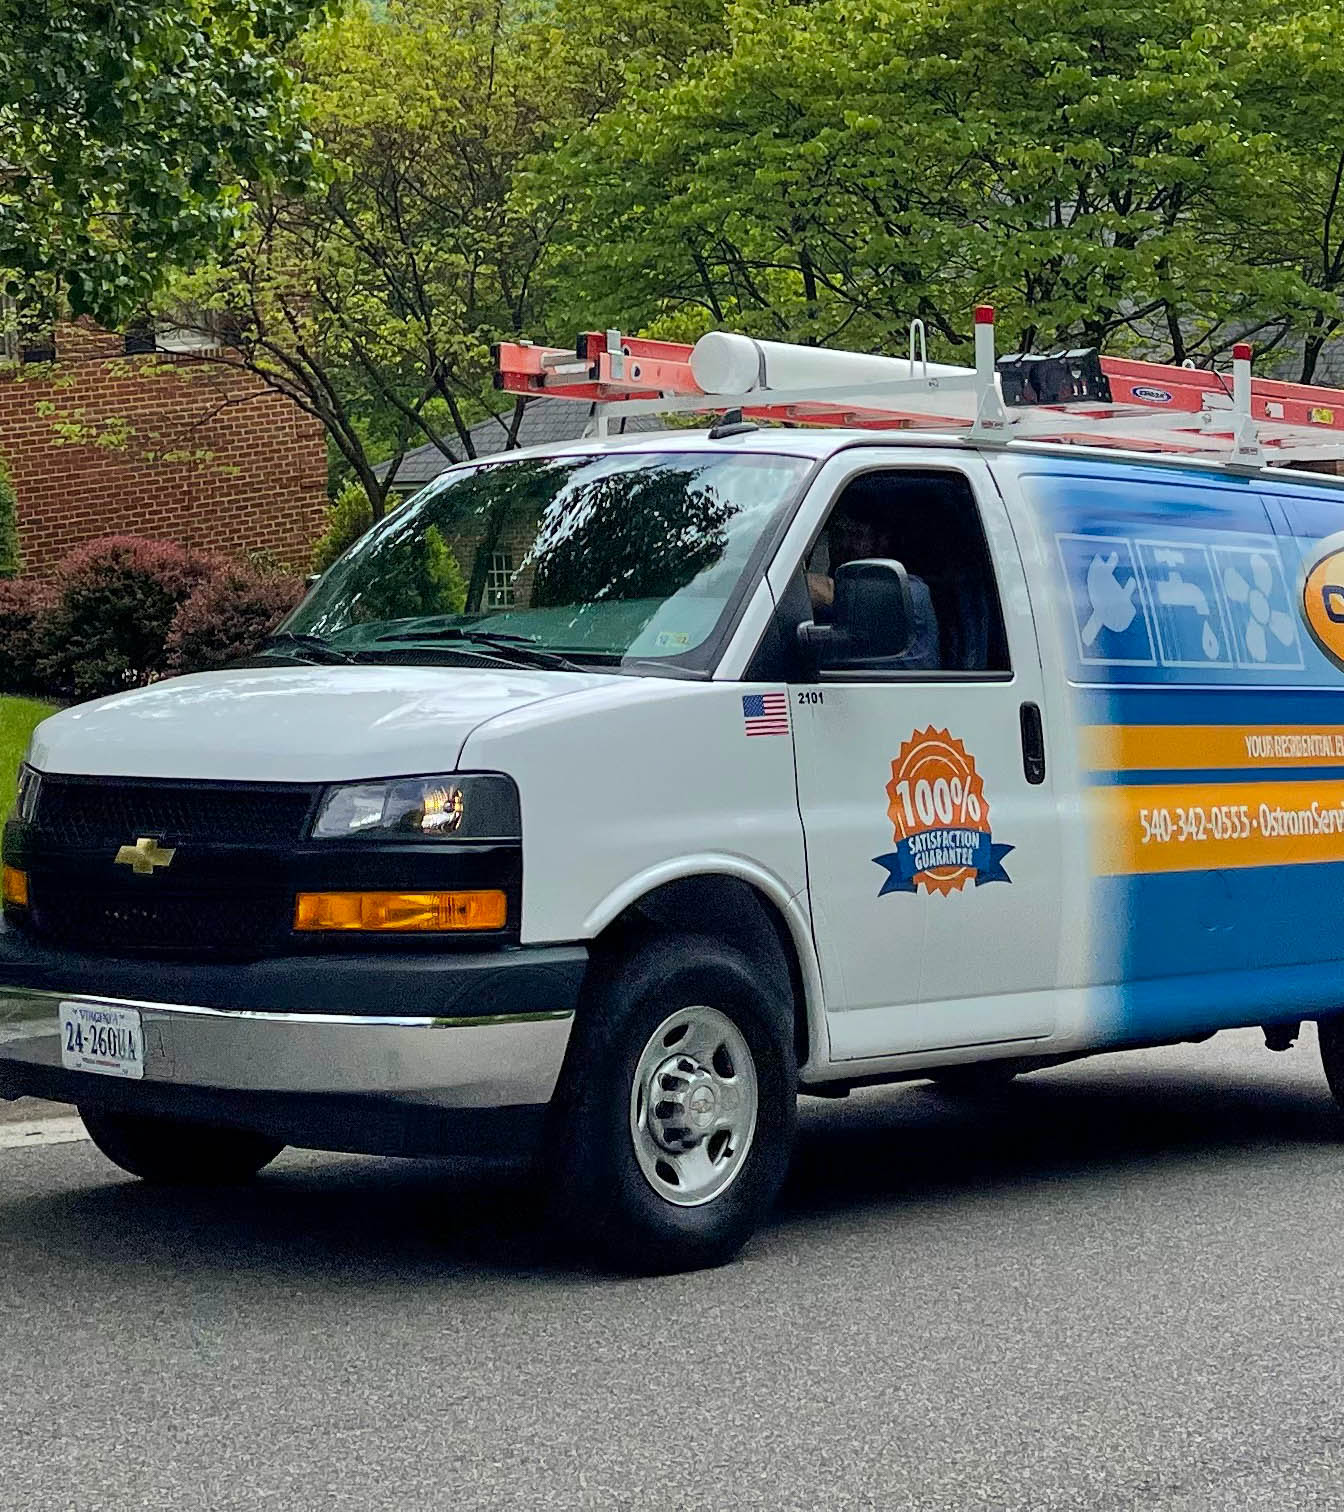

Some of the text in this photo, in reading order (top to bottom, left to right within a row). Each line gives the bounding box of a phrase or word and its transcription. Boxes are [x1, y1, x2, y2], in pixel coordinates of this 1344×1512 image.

[798, 691, 823, 705] 2101
[1244, 735, 1274, 758] YOUR
[1275, 735, 1335, 758] RESIDENTIAL
[896, 775, 981, 828] 100%
[1139, 805, 1251, 844] 540-342-0555
[908, 830, 980, 855] SATISFACTION
[915, 848, 973, 871] GUARANTEE
